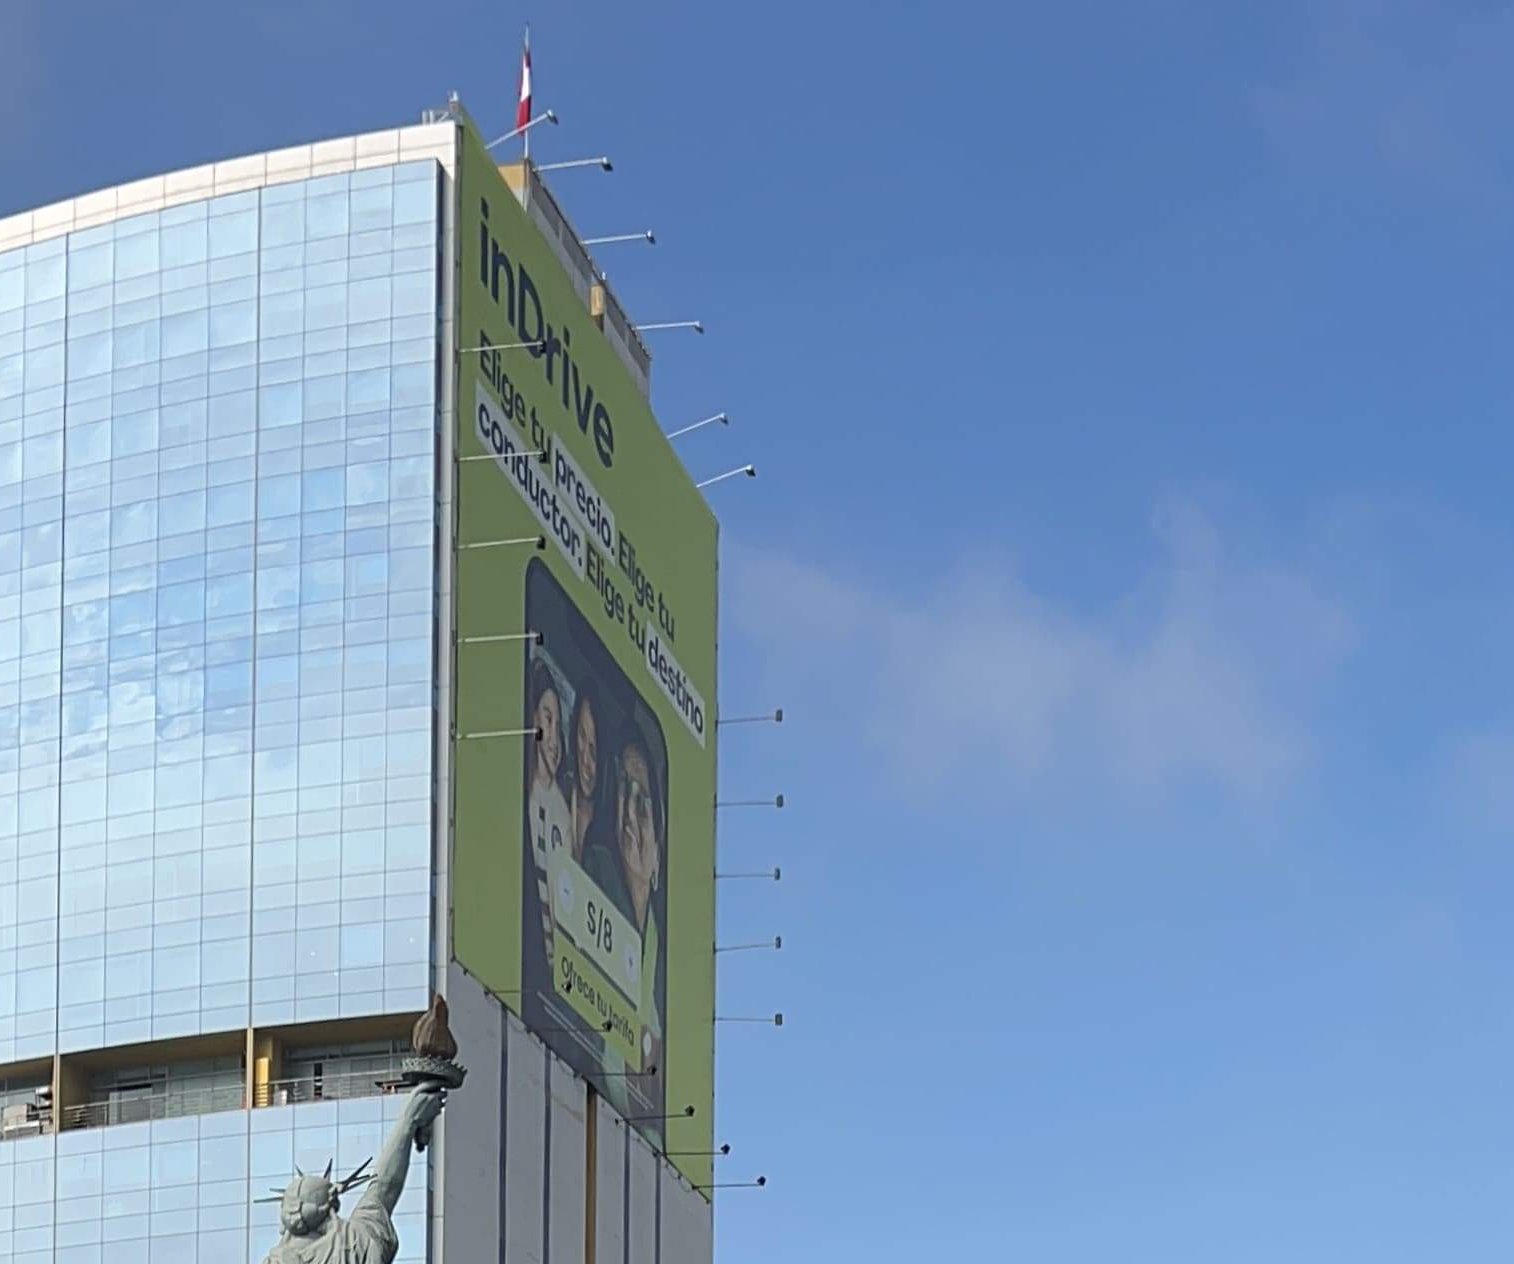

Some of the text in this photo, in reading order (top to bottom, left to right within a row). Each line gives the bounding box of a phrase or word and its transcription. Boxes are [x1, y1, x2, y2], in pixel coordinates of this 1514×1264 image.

[480, 197, 614, 468] inDrive
[478, 403, 704, 735] conductor. Elige tu destino
[480, 329, 675, 642] Elige tu precio. Elige tu
[587, 901, 613, 954] S/8
[594, 991, 608, 1018] tu
